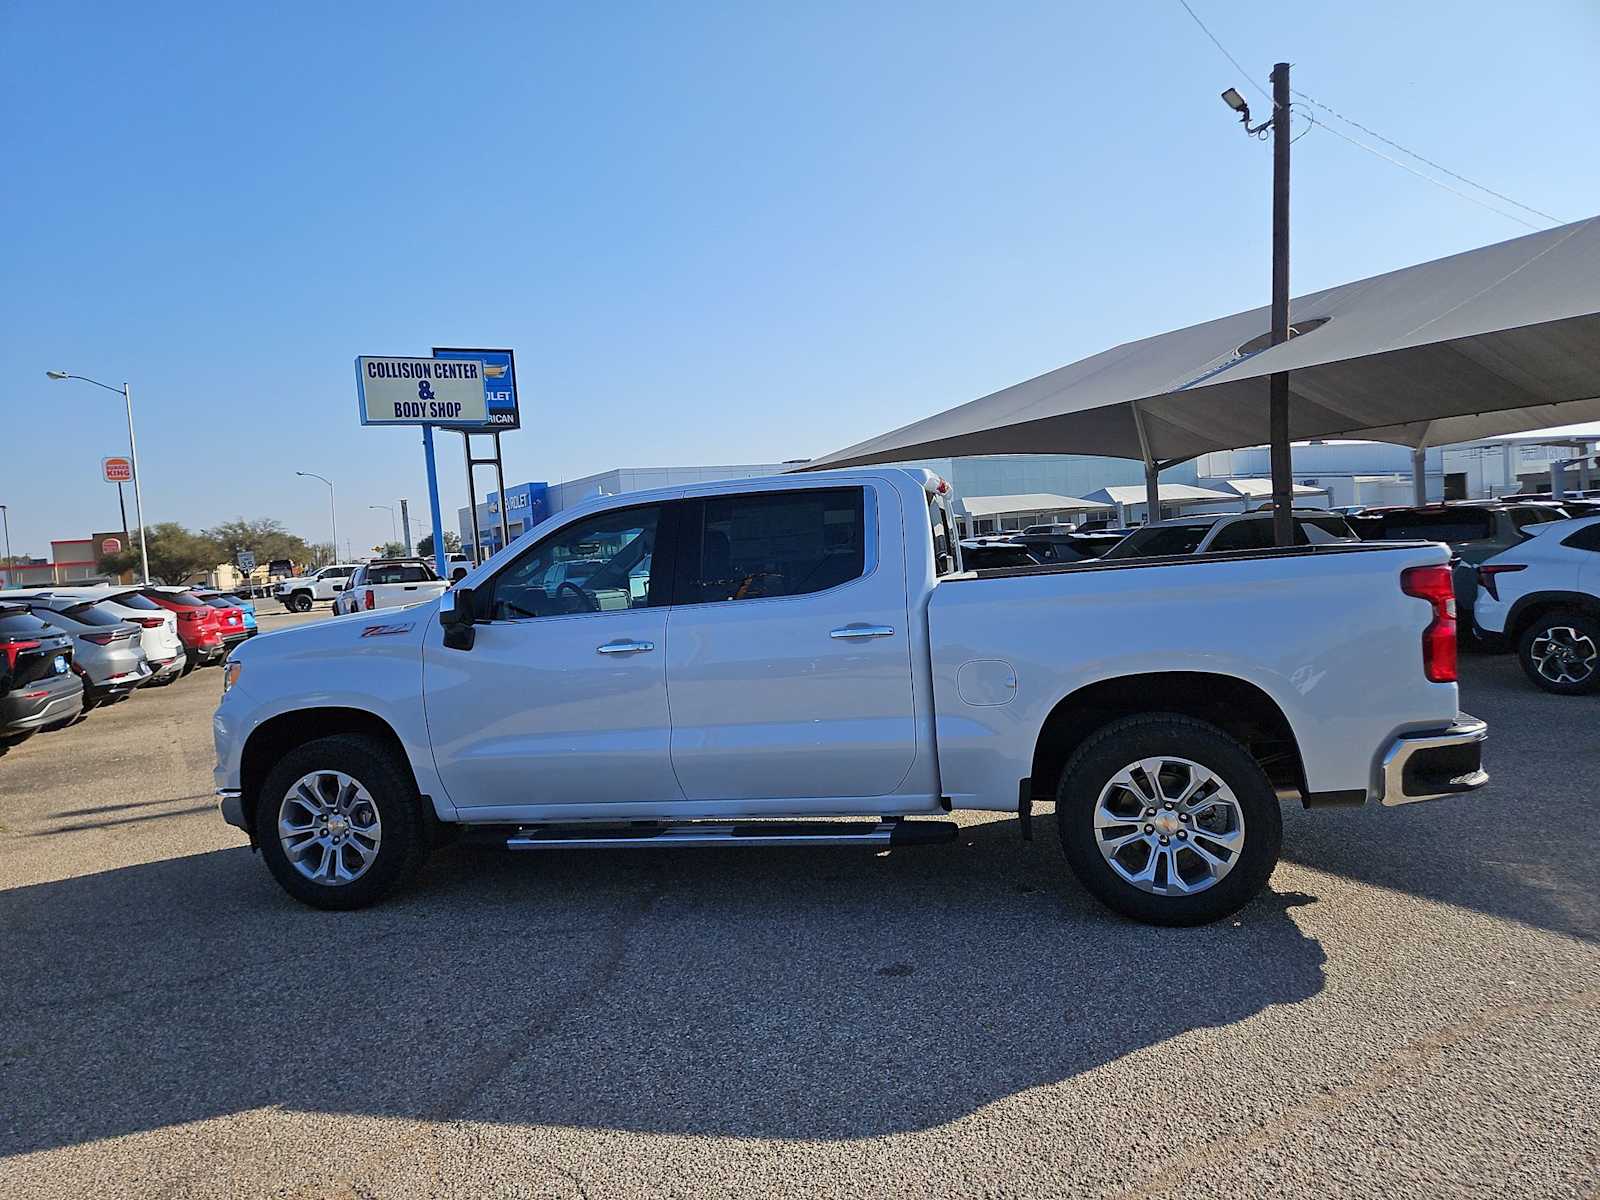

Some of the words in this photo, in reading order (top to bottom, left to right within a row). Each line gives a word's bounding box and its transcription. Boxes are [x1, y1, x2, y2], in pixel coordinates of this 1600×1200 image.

[367, 362, 431, 378] COLLISION
[434, 363, 477, 379] CENTER
[418, 380, 435, 400] &
[394, 402, 426, 417] BODY
[430, 402, 461, 417] SHOP
[488, 414, 514, 424] RICAN
